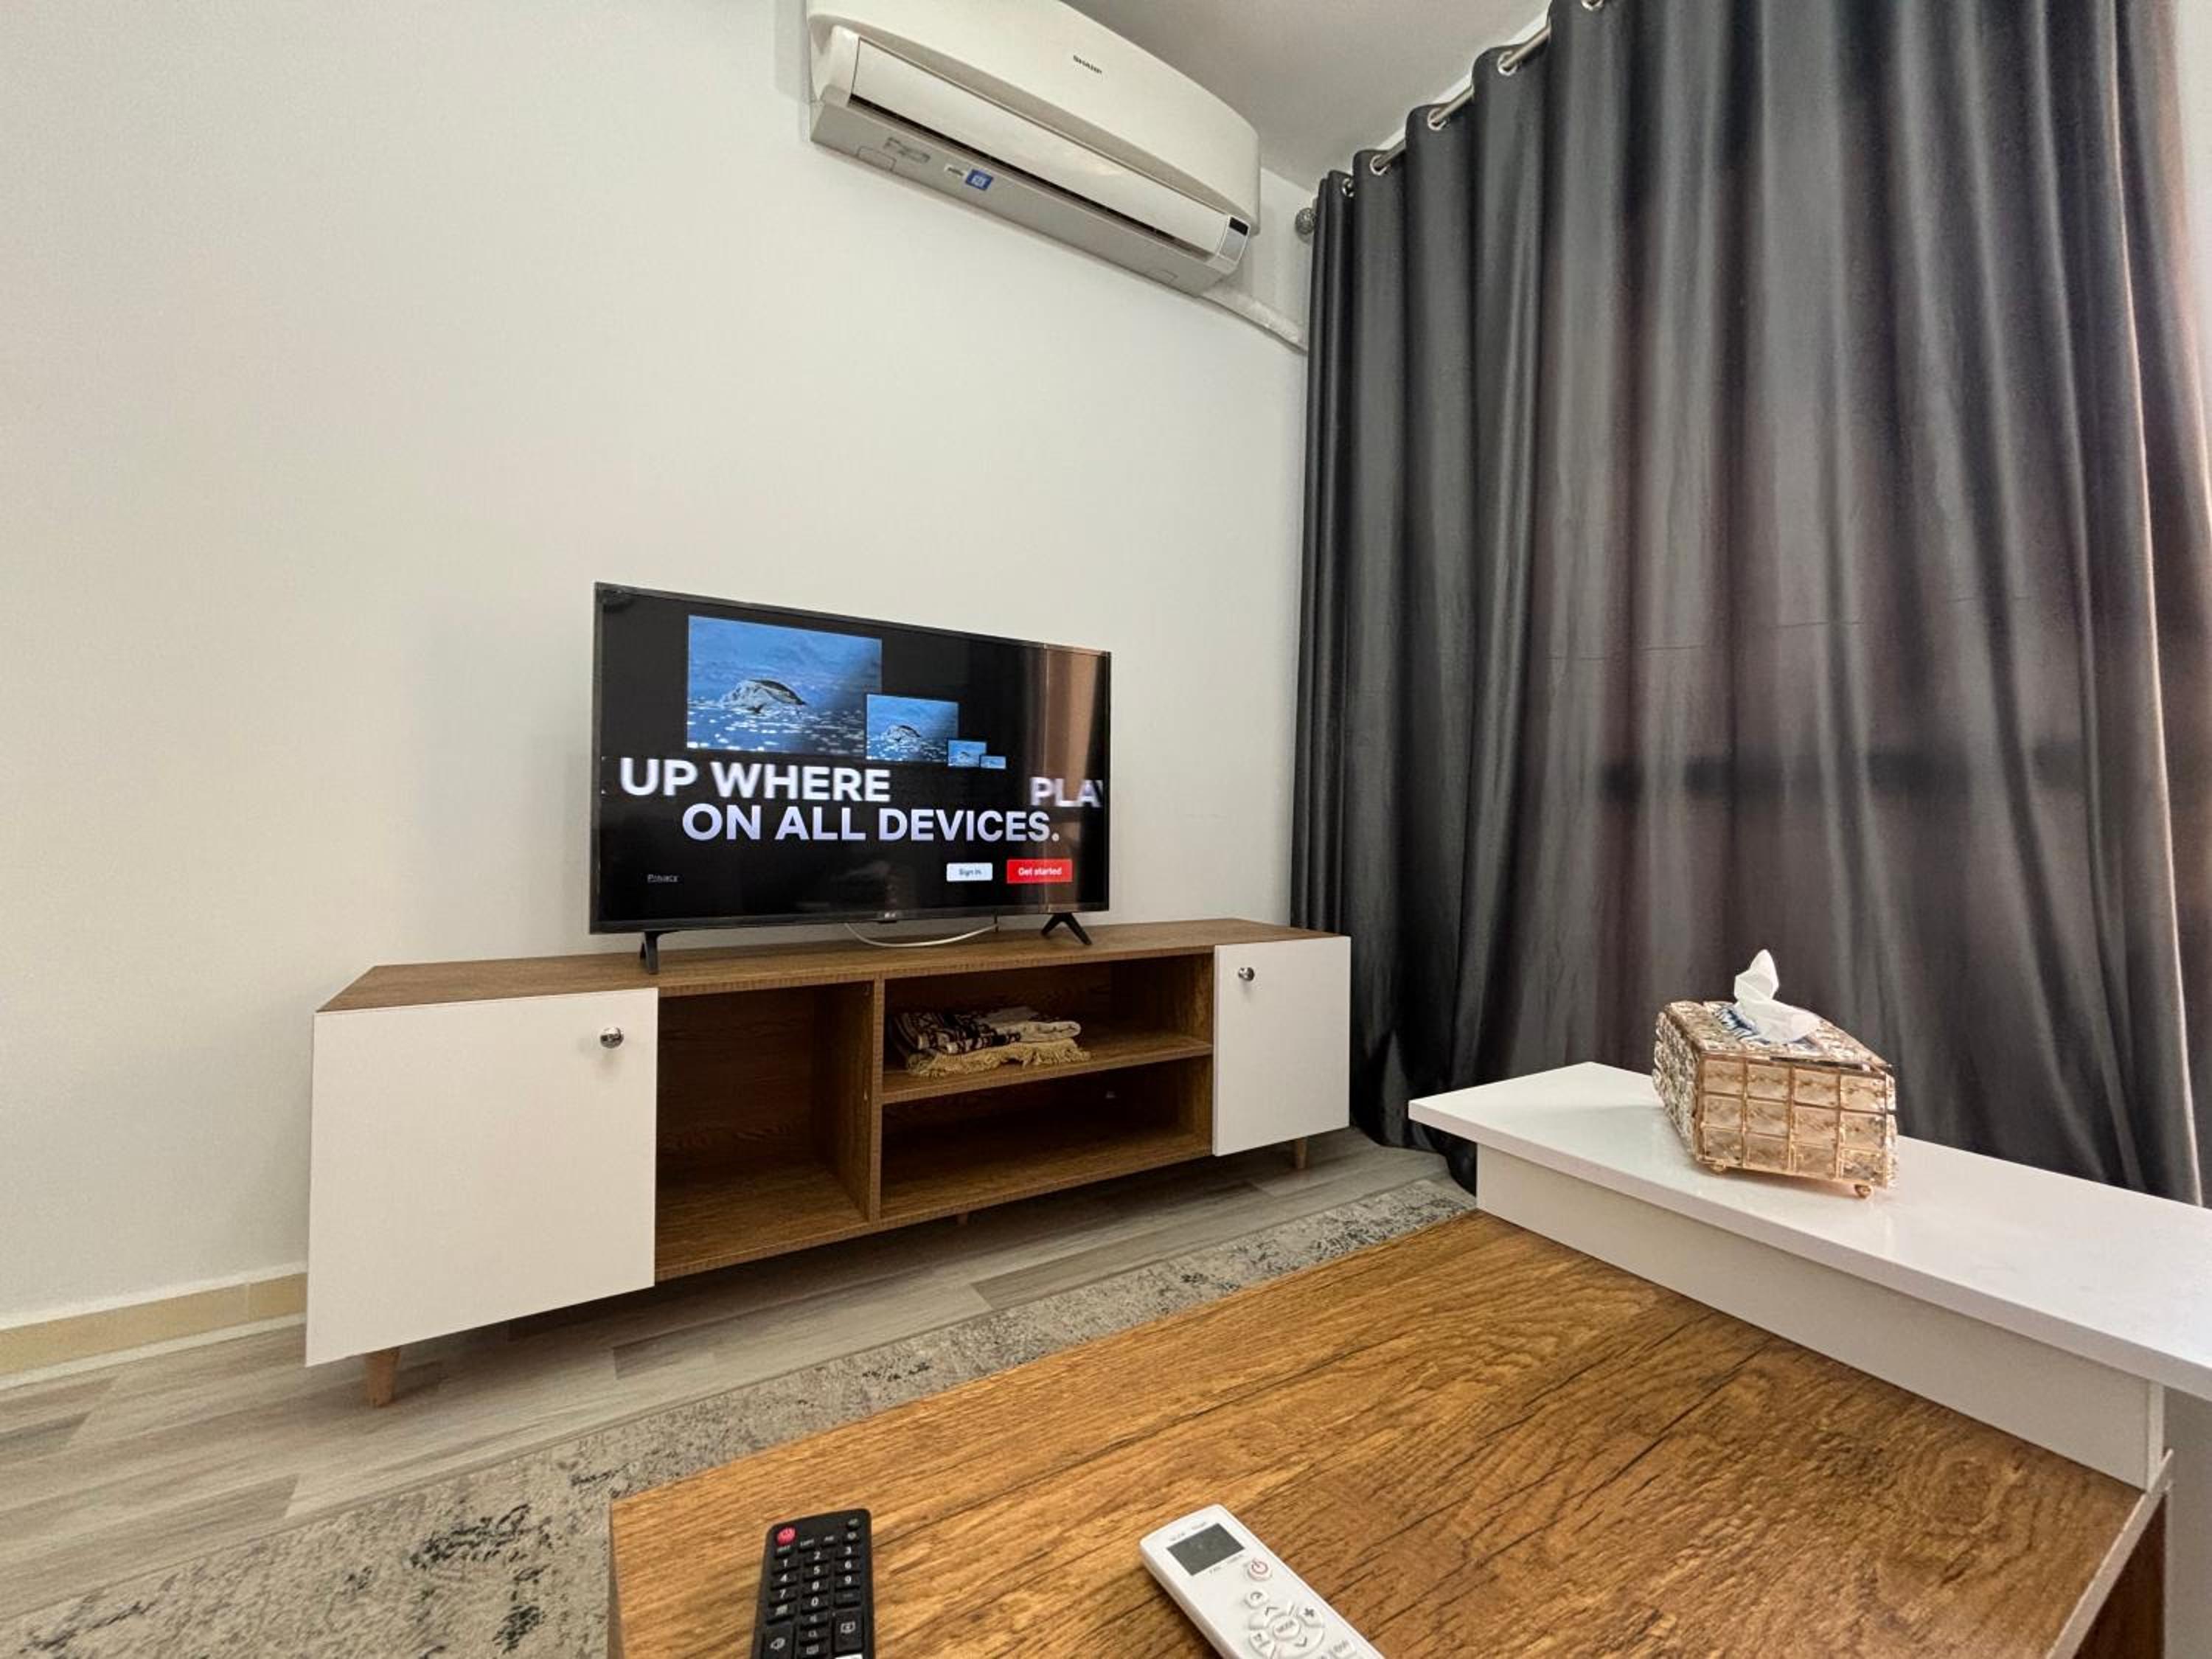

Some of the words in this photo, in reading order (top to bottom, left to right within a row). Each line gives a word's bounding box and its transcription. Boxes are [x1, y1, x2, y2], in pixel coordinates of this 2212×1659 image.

[620, 757, 698, 796] UP
[710, 761, 891, 802] WHERE
[682, 802, 762, 841] ON
[774, 805, 866, 841] ALL
[878, 807, 1060, 842] DEVICES.
[1018, 867, 1033, 876] Get
[1034, 867, 1062, 876] started
[814, 1551, 821, 1560] 2
[783, 1559, 788, 1568] 1
[844, 1560, 852, 1569] 6
[813, 1565, 821, 1575] 5
[780, 1573, 787, 1582] 4
[844, 1575, 852, 1585] 9
[779, 1589, 787, 1599] 7
[811, 1596, 819, 1607] 0
